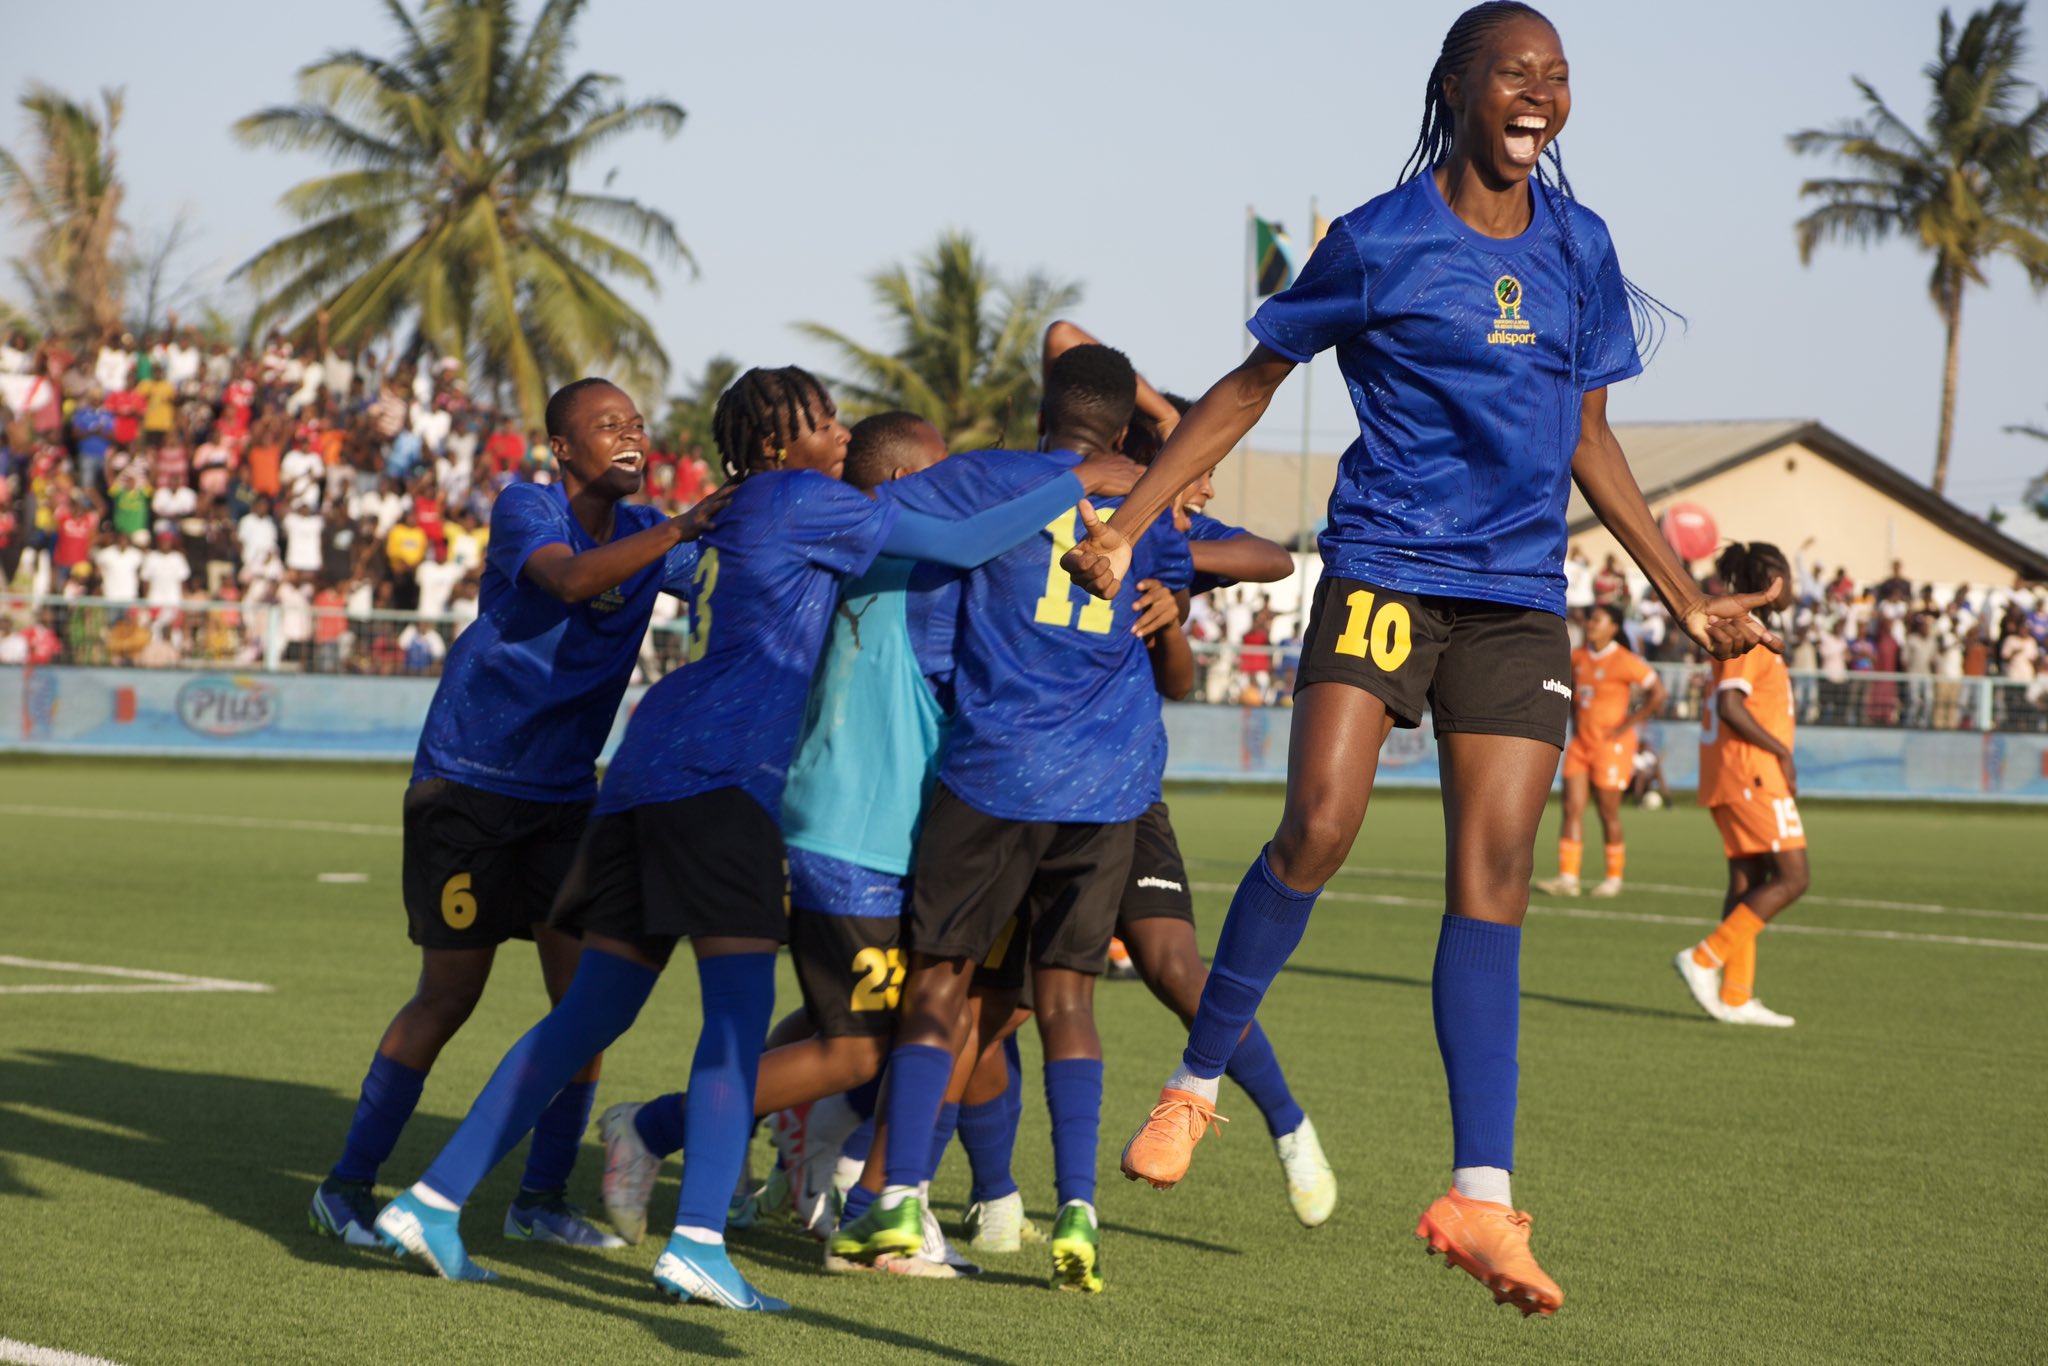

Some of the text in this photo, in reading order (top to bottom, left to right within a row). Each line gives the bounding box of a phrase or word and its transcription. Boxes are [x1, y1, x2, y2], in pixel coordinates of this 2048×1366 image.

[1487, 329, 1537, 346] uhlsport
[689, 546, 719, 664] 3
[1335, 589, 1412, 672] 10
[187, 687, 271, 723] Plus
[1772, 797, 1804, 839] 15
[441, 872, 478, 930] 6
